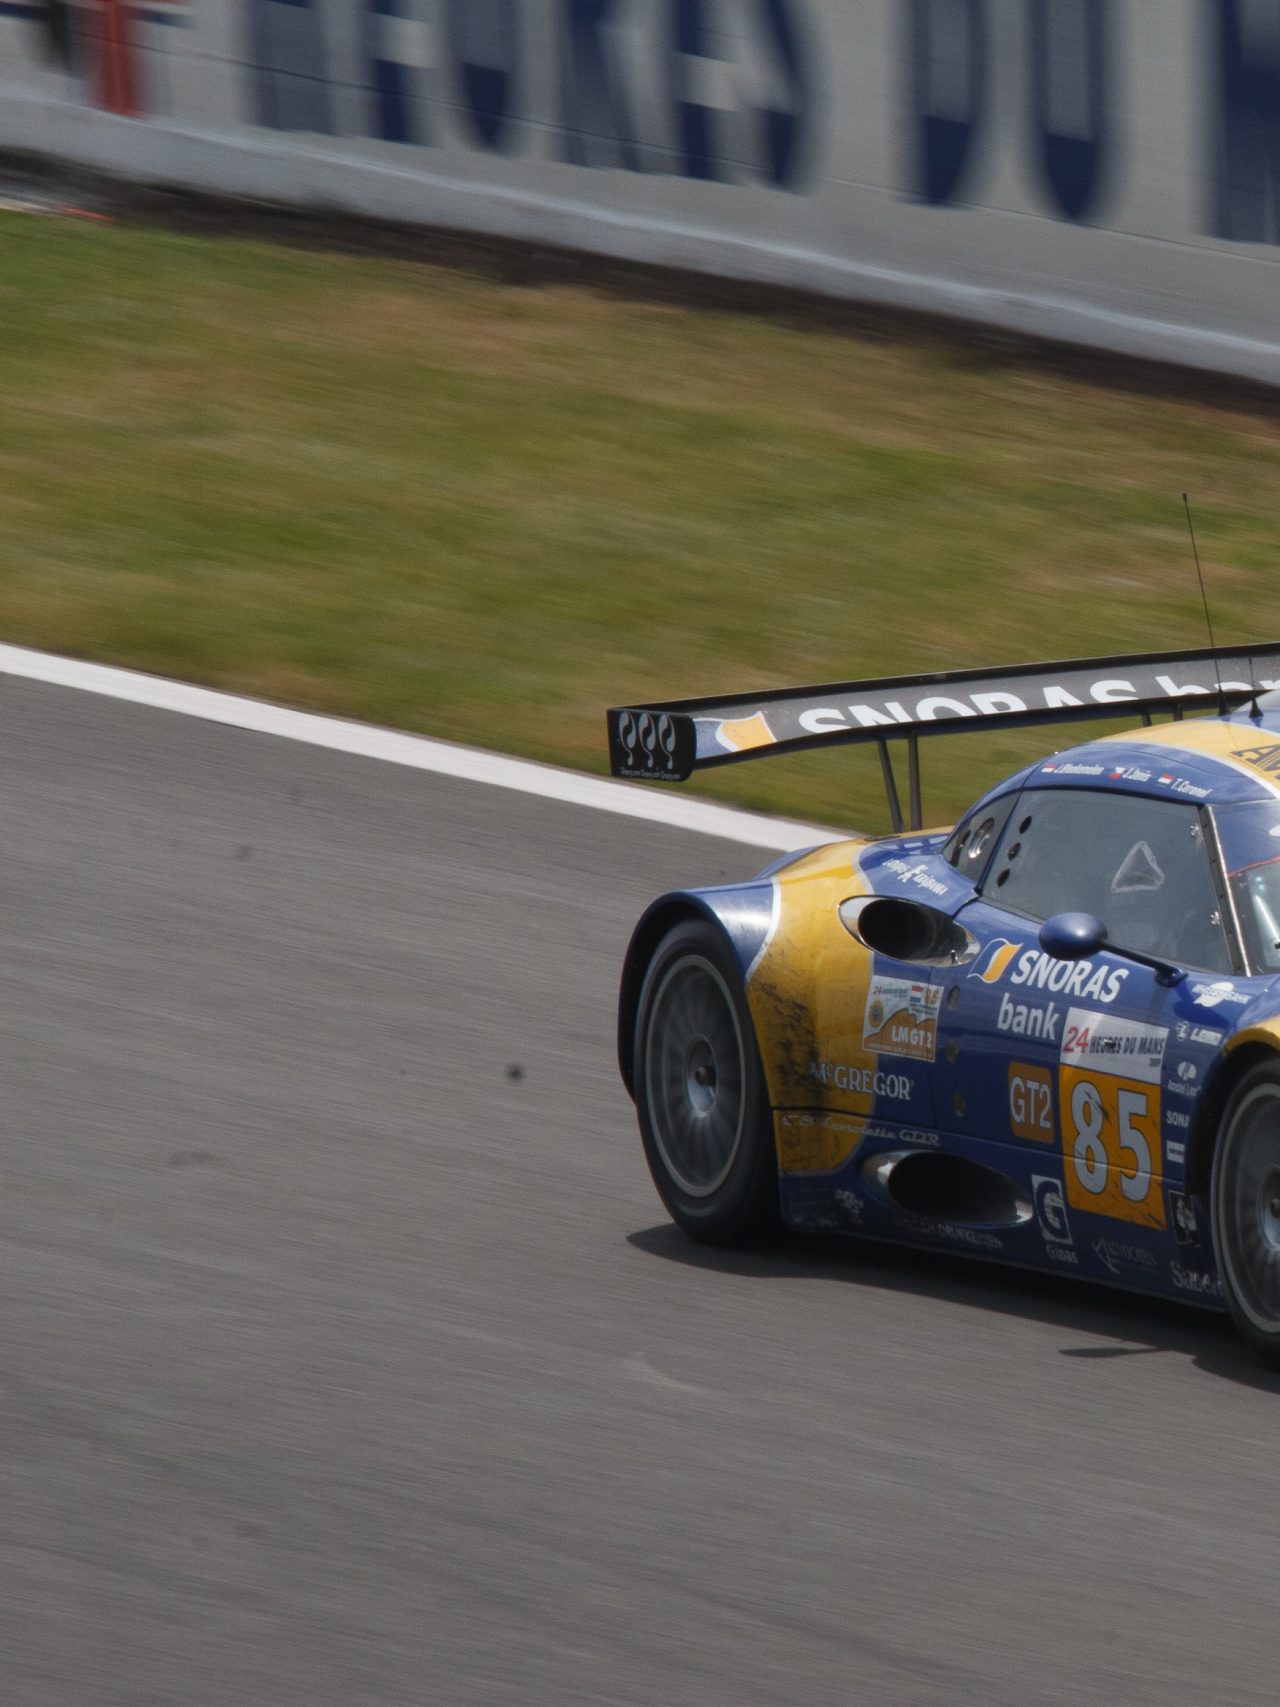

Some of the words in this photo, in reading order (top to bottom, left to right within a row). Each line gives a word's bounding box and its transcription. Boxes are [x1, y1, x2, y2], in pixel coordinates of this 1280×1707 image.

[1010, 950, 1130, 1003] SNORAS
[997, 992, 1060, 1041] bank
[1063, 1026, 1089, 1054] 24
[1123, 1036, 1138, 1054] DU
[1138, 1036, 1165, 1055] MANS
[1010, 1076, 1052, 1129] GT2
[1071, 1080, 1152, 1202] 85
